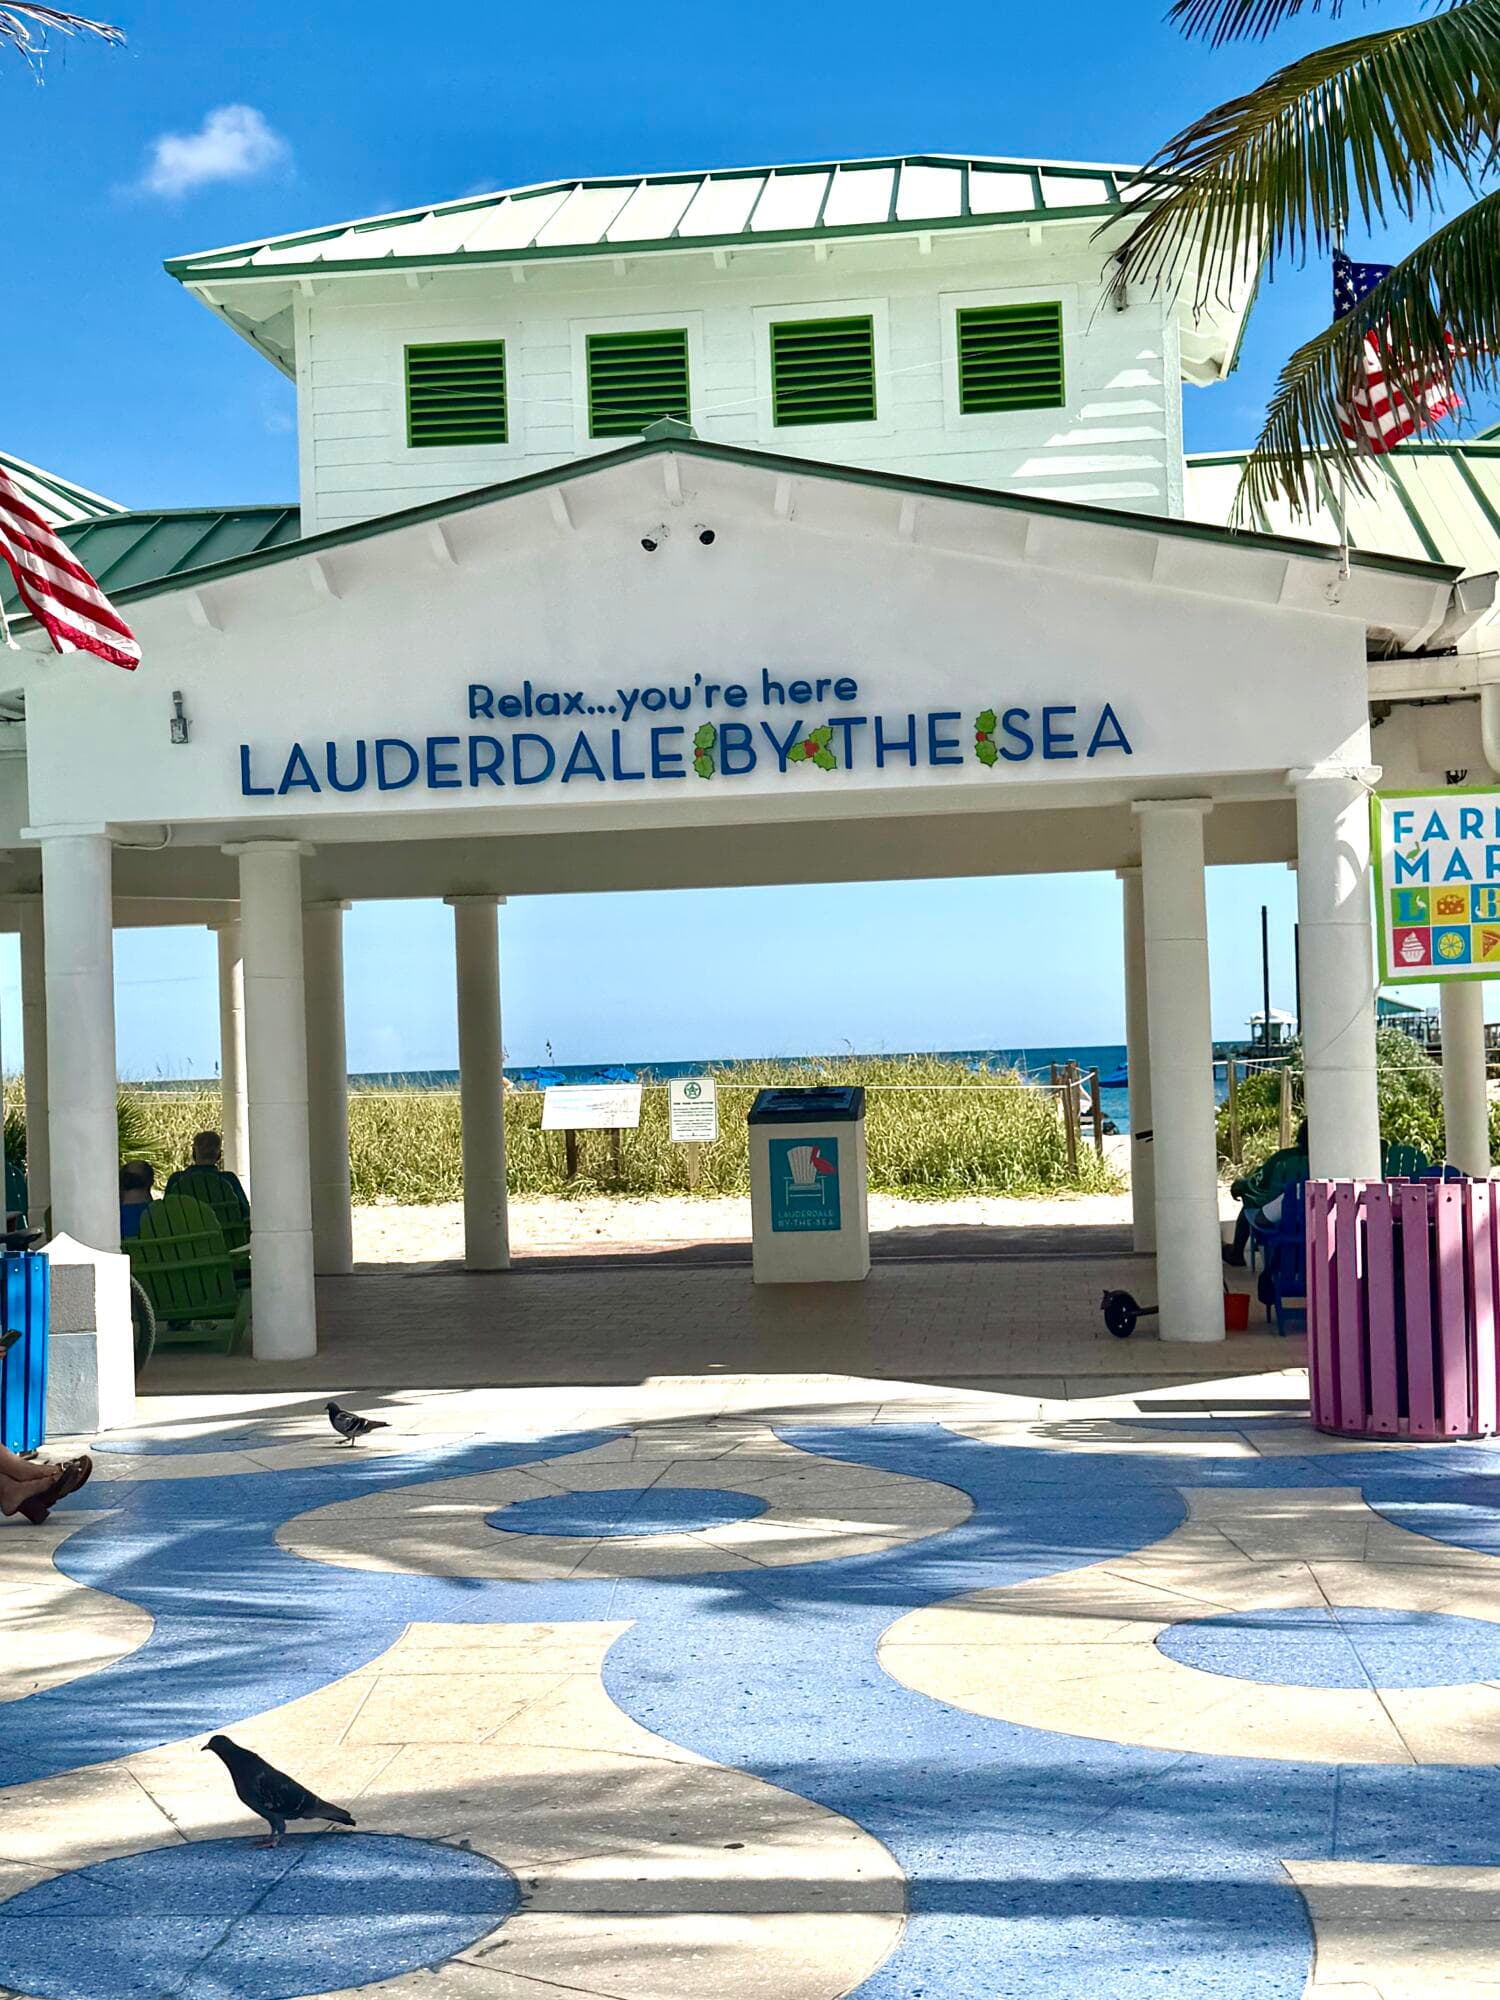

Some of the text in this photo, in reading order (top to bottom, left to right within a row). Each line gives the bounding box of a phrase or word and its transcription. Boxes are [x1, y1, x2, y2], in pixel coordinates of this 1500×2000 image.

[762, 668, 858, 706] here
[240, 702, 1133, 796] LAUDERDALE BY THE SEA
[1393, 806, 1500, 843] FAR
